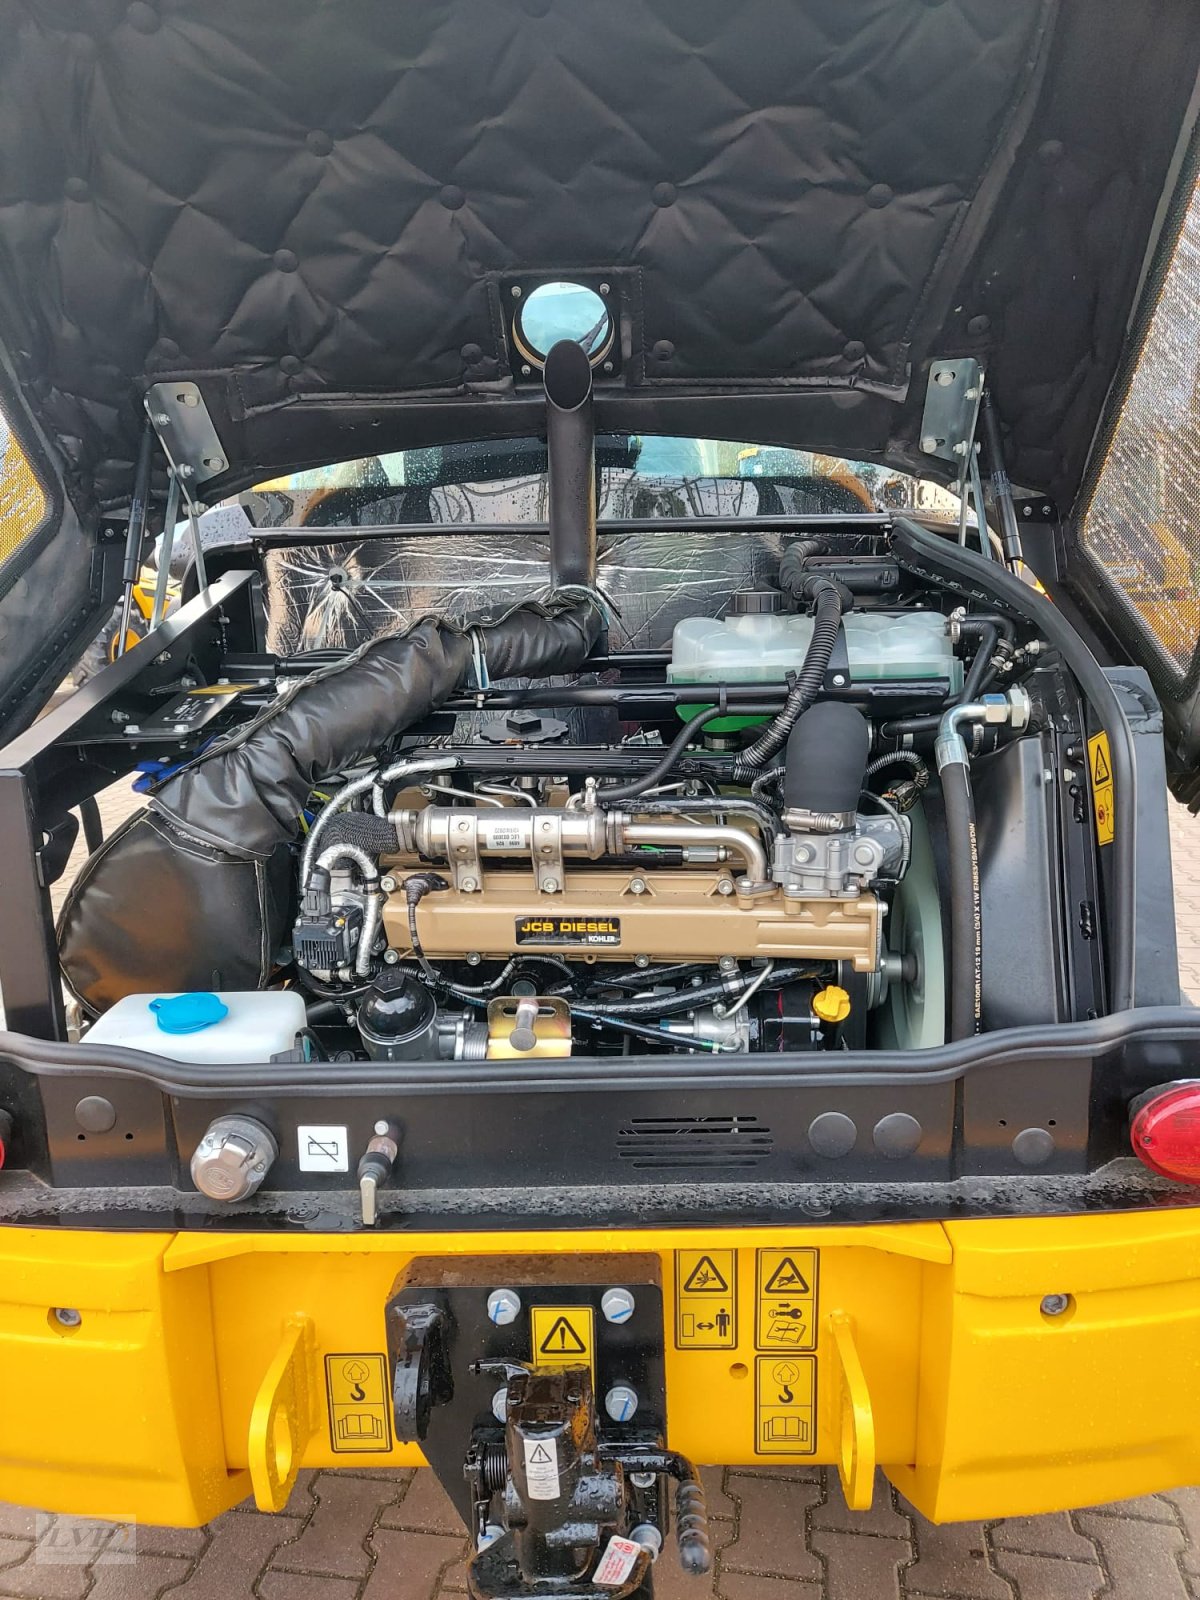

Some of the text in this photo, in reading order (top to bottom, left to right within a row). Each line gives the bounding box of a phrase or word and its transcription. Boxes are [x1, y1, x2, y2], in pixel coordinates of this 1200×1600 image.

[521, 922, 618, 932] JCB DIESEL
[588, 935, 618, 943] KOHLER
